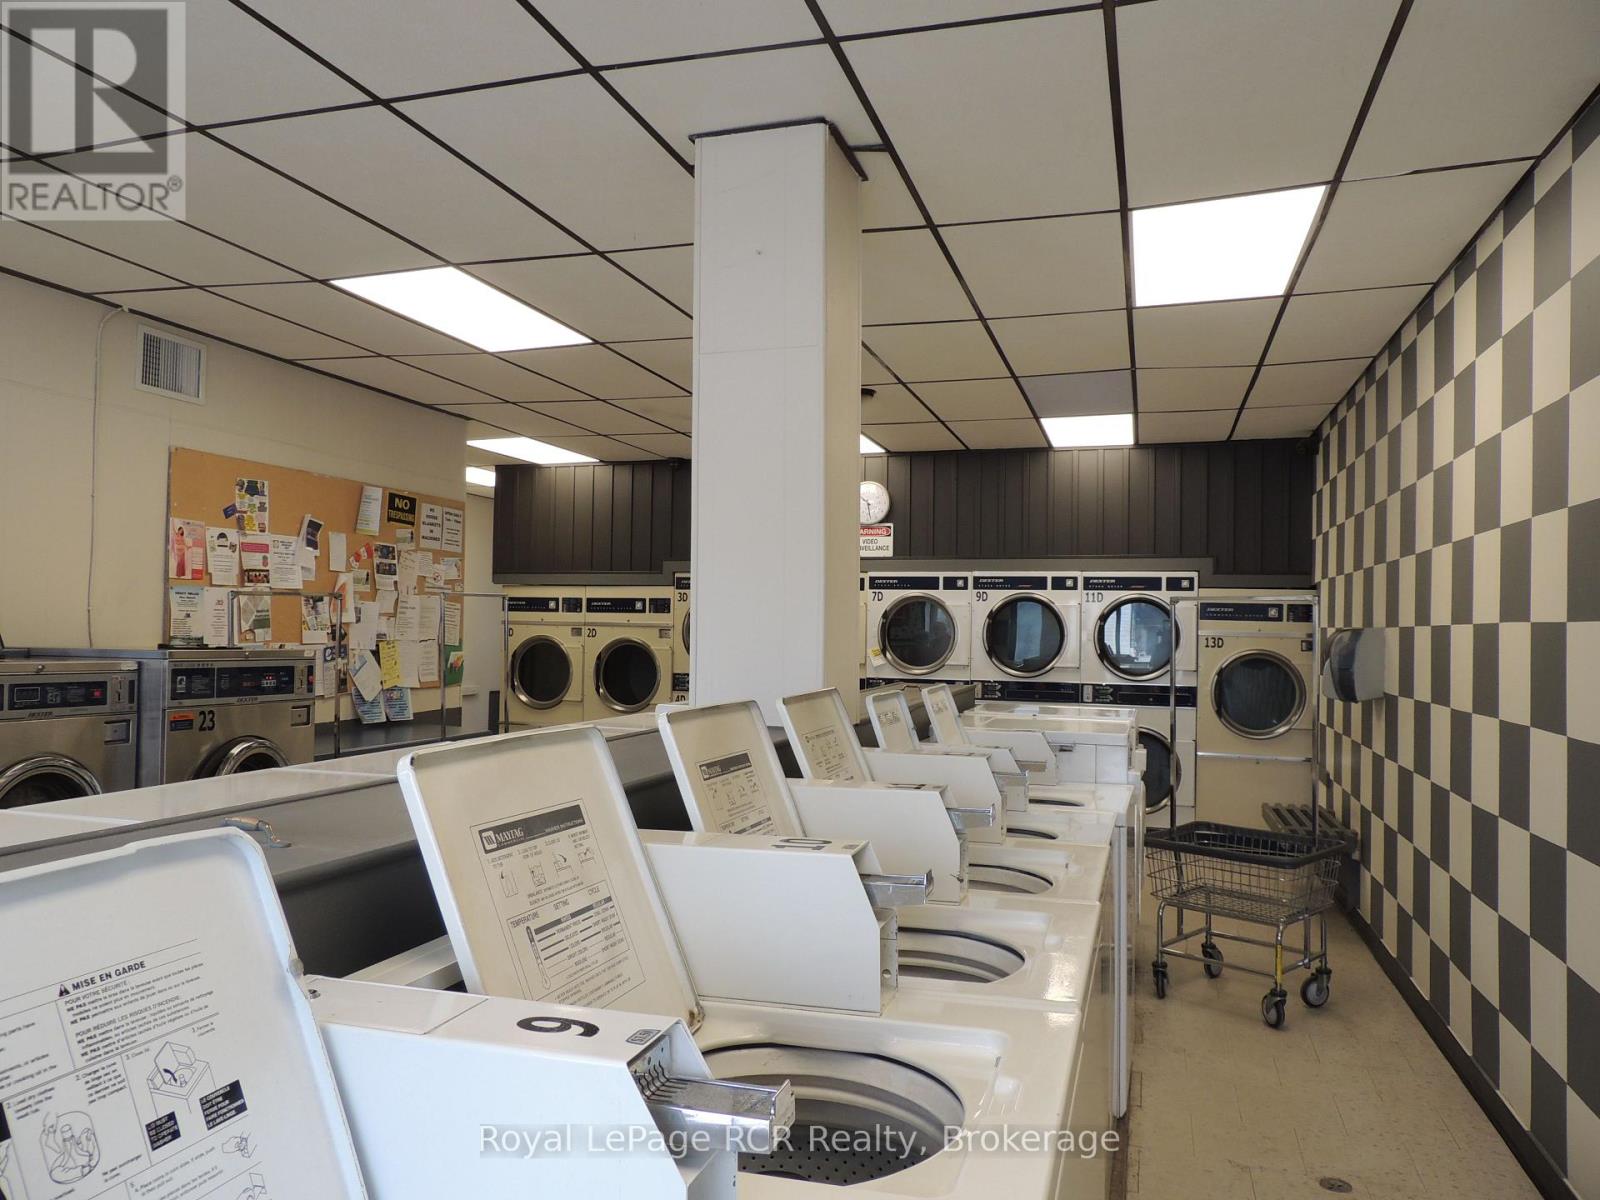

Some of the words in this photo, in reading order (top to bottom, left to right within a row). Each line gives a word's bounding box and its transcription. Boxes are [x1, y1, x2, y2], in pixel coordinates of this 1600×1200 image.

[394, 498, 410, 510] NO
[678, 592, 688, 602] 3D
[872, 591, 884, 602] 7D
[976, 591, 988, 602] 9D
[1085, 592, 1104, 603] 11D
[587, 628, 597, 638] 2D
[1205, 638, 1224, 648] 13D
[198, 710, 216, 732] 23
[495, 827, 524, 842] MAYTAG
[510, 911, 540, 928] TEMPERATURE
[553, 898, 570, 911] SETTING
[587, 886, 600, 896] CYCLE
[72, 977, 96, 991] MISE
[99, 972, 112, 982] EN
[115, 961, 146, 976] GARDE
